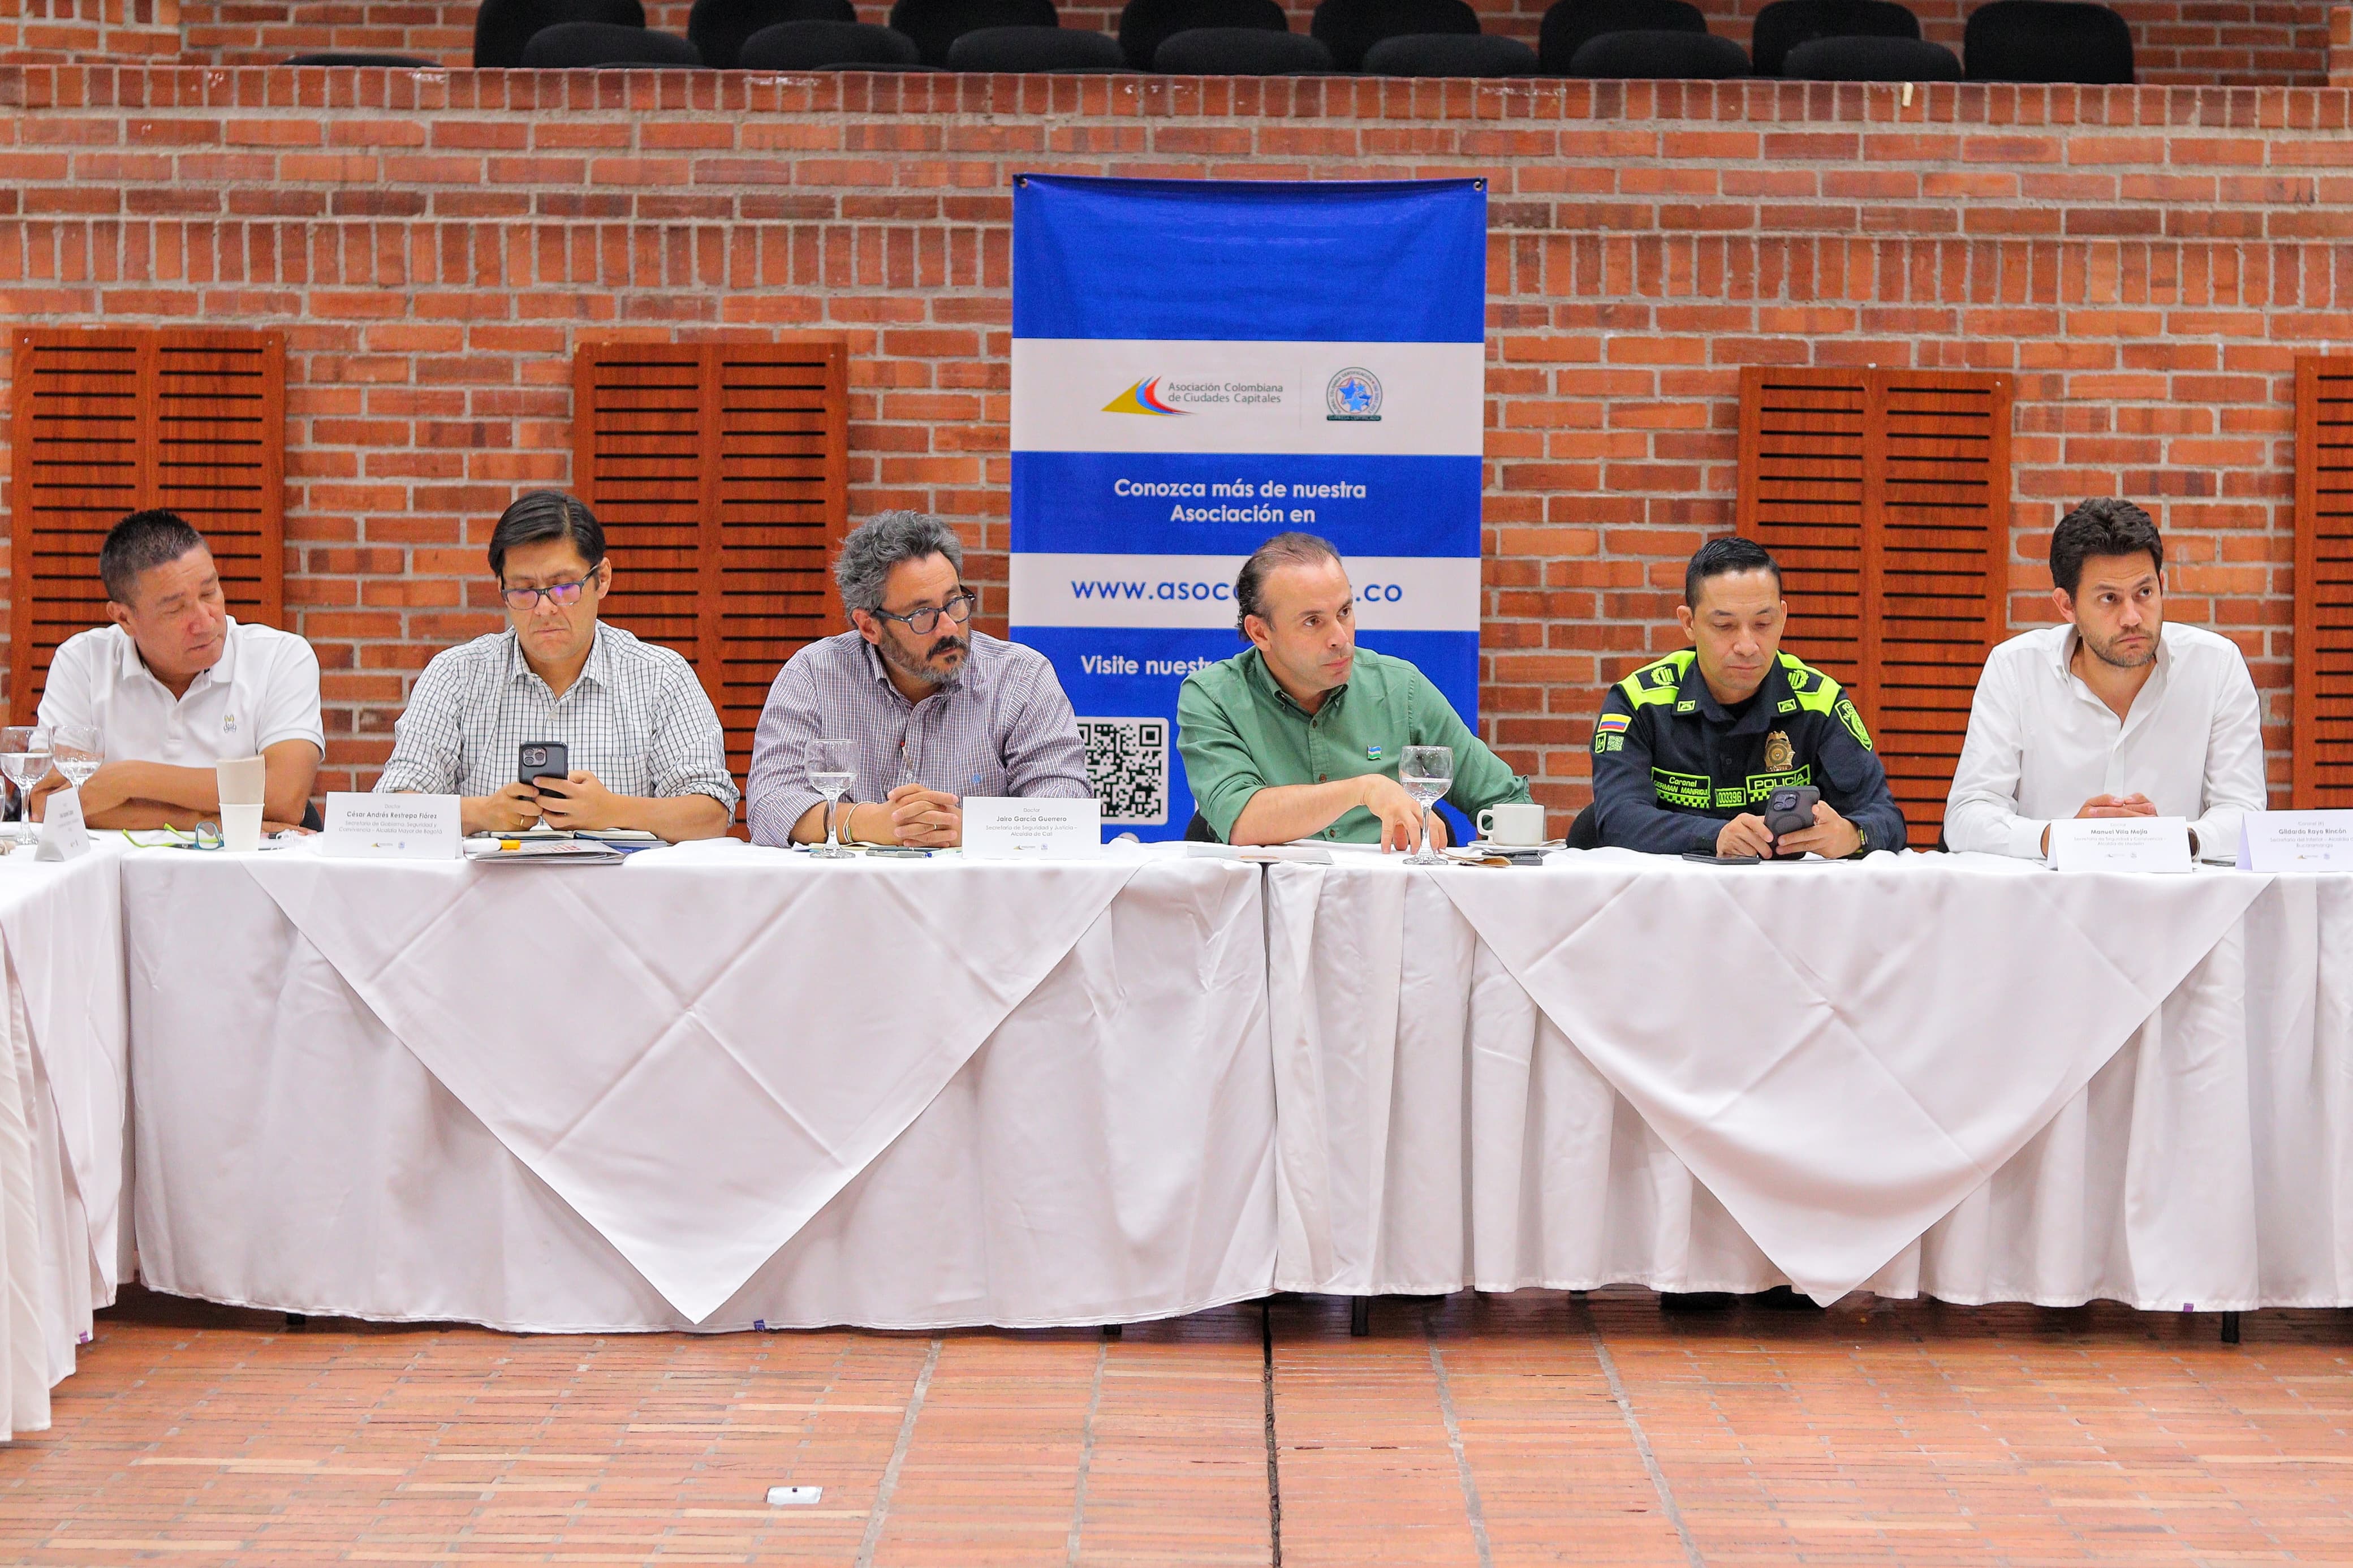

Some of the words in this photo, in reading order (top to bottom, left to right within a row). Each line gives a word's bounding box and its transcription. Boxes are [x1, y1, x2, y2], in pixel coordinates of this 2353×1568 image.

[1168, 382, 1220, 391] Asociación
[1225, 382, 1283, 392] Colombiana
[1168, 393, 1181, 402] de
[1184, 393, 1230, 402] Ciudades
[1234, 393, 1281, 404] Capitales
[1114, 478, 1206, 497] Conozca
[1212, 478, 1254, 497] más
[1260, 480, 1287, 497] de
[1293, 480, 1367, 498] nuestra
[1170, 503, 1285, 523] Asociación
[1290, 508, 1316, 523] en
[1080, 654, 1139, 674] Visite
[1145, 656, 1213, 674] nuestr
[1653, 780, 1679, 793] GERMAN
[1669, 776, 1697, 787] Coronel
[1754, 773, 1804, 790] POLICÍA
[1718, 791, 1742, 804] 003396
